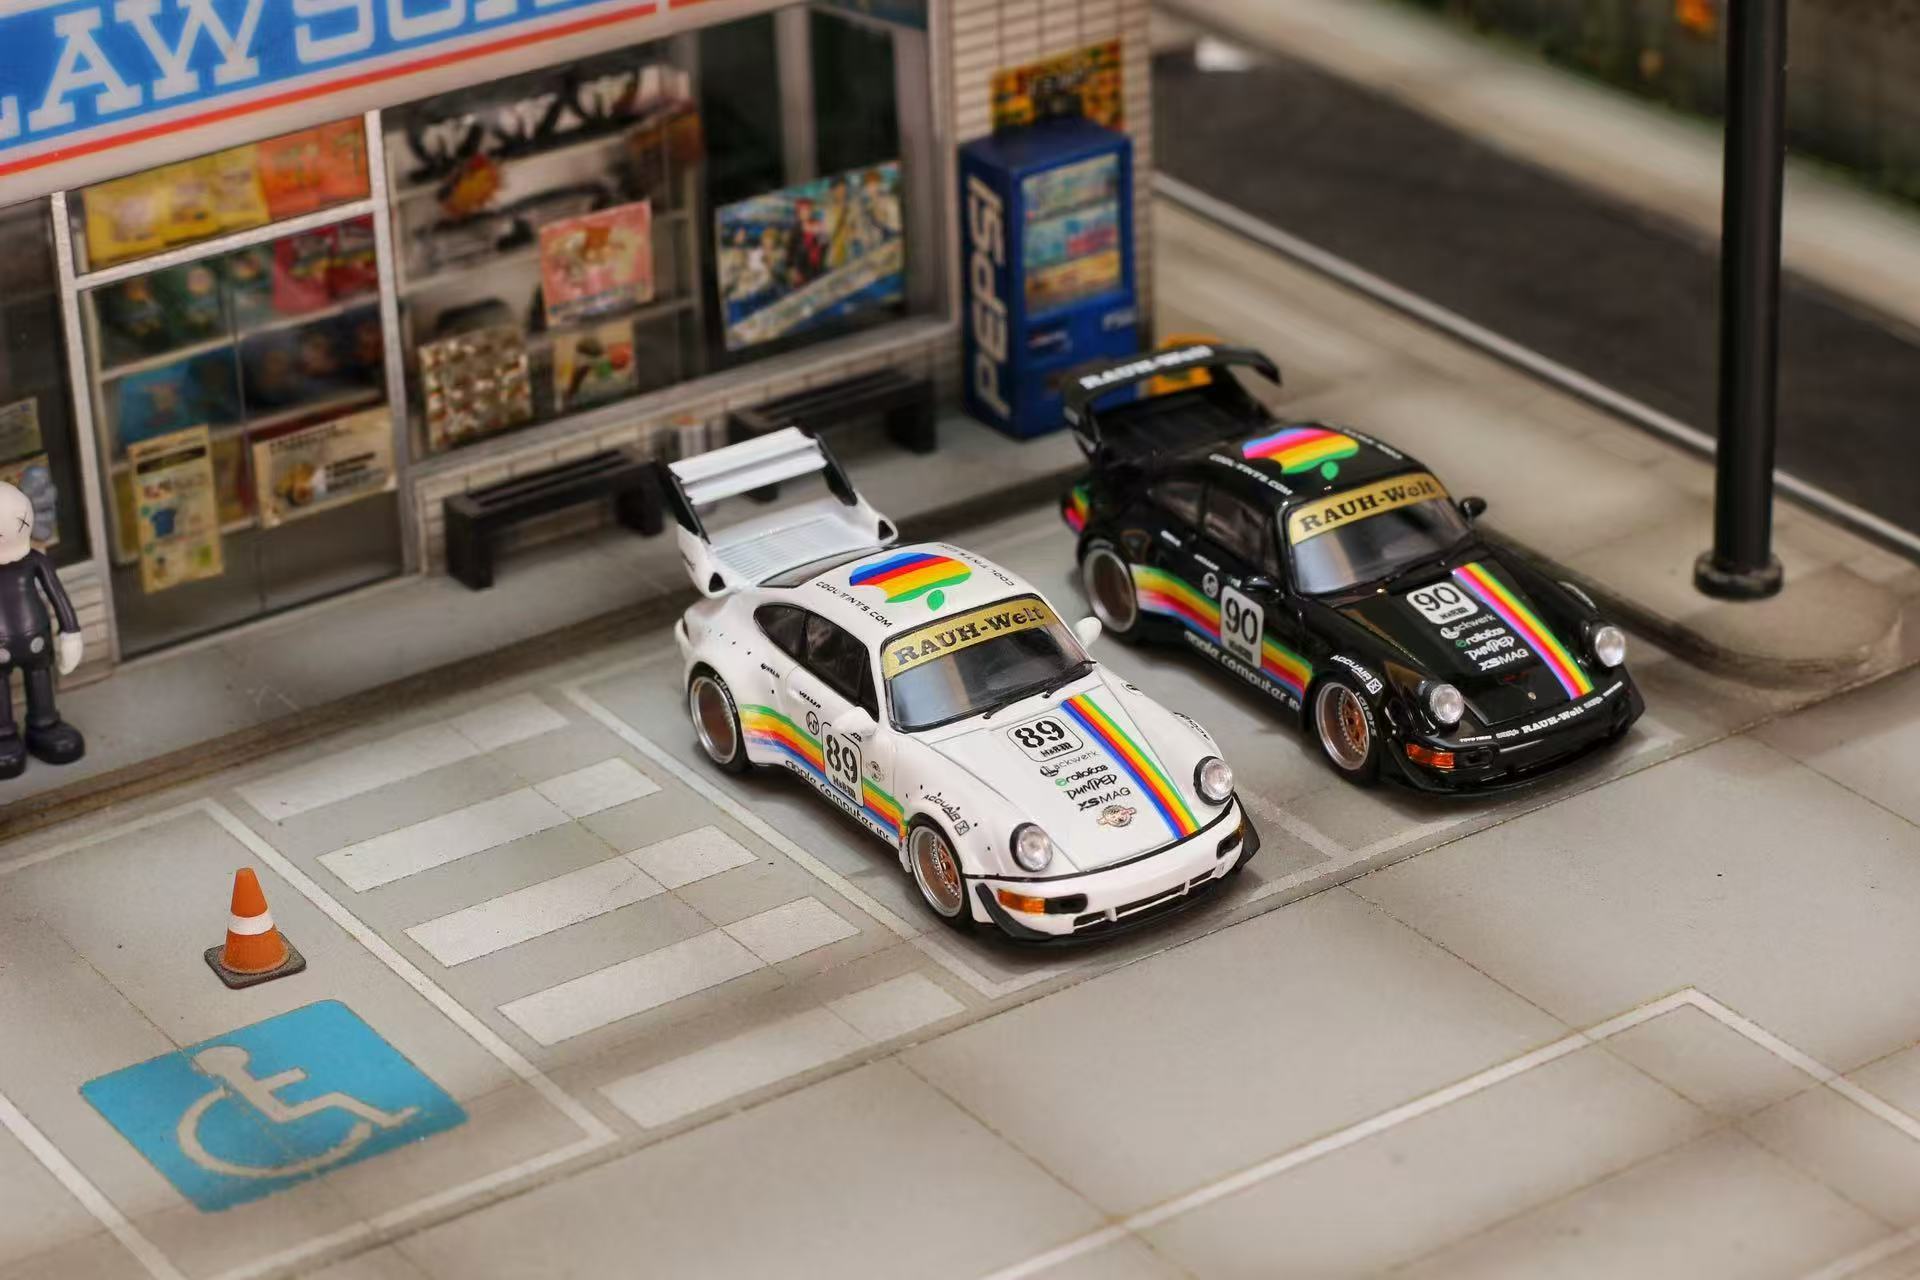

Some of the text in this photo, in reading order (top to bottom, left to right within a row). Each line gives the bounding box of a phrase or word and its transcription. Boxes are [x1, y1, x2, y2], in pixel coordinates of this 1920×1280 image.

[0, 0, 582, 137] AWS
[968, 174, 1010, 418] PEPSI
[1299, 480, 1435, 532] RAUH-Welt
[1225, 597, 1259, 645] 90
[1413, 586, 1461, 611] 90
[894, 606, 1045, 666] RAUH-Welt
[1014, 720, 1065, 748] 89
[1521, 705, 1585, 734] RAUH-Welt
[826, 734, 858, 783] 89
[820, 783, 874, 830] computer
[923, 794, 962, 822] ACCUAIR
